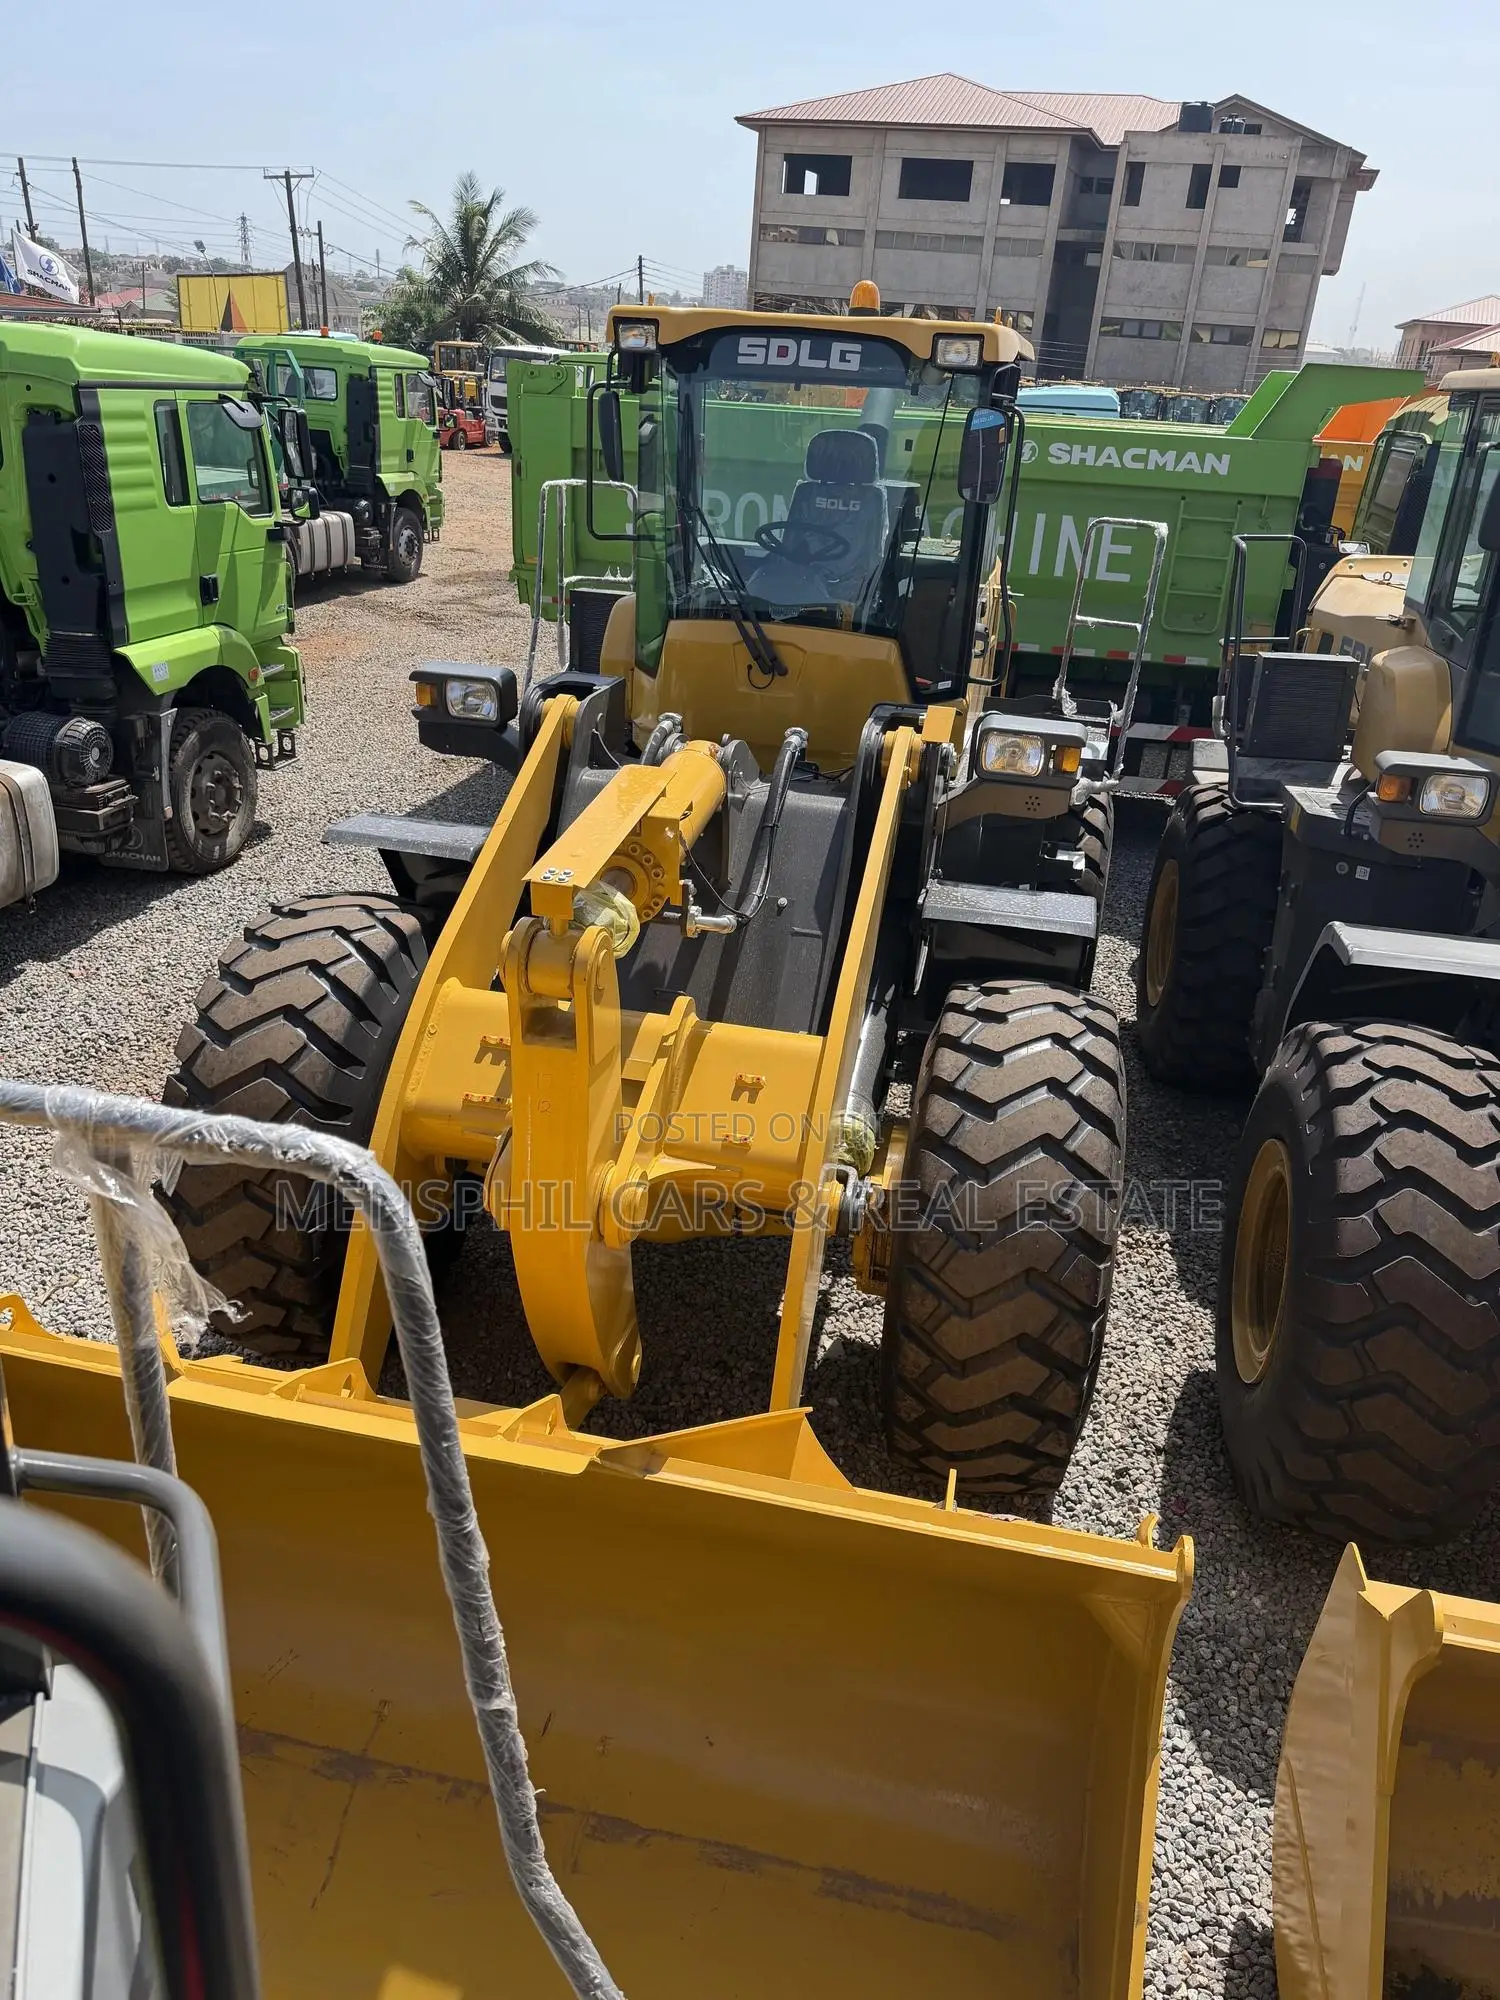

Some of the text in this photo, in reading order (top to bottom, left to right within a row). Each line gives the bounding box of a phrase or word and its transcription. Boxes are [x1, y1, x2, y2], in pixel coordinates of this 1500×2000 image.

[737, 336, 862, 372] SDLG
[1047, 442, 1231, 476] SHACMAN
[815, 497, 861, 511] SDLG
